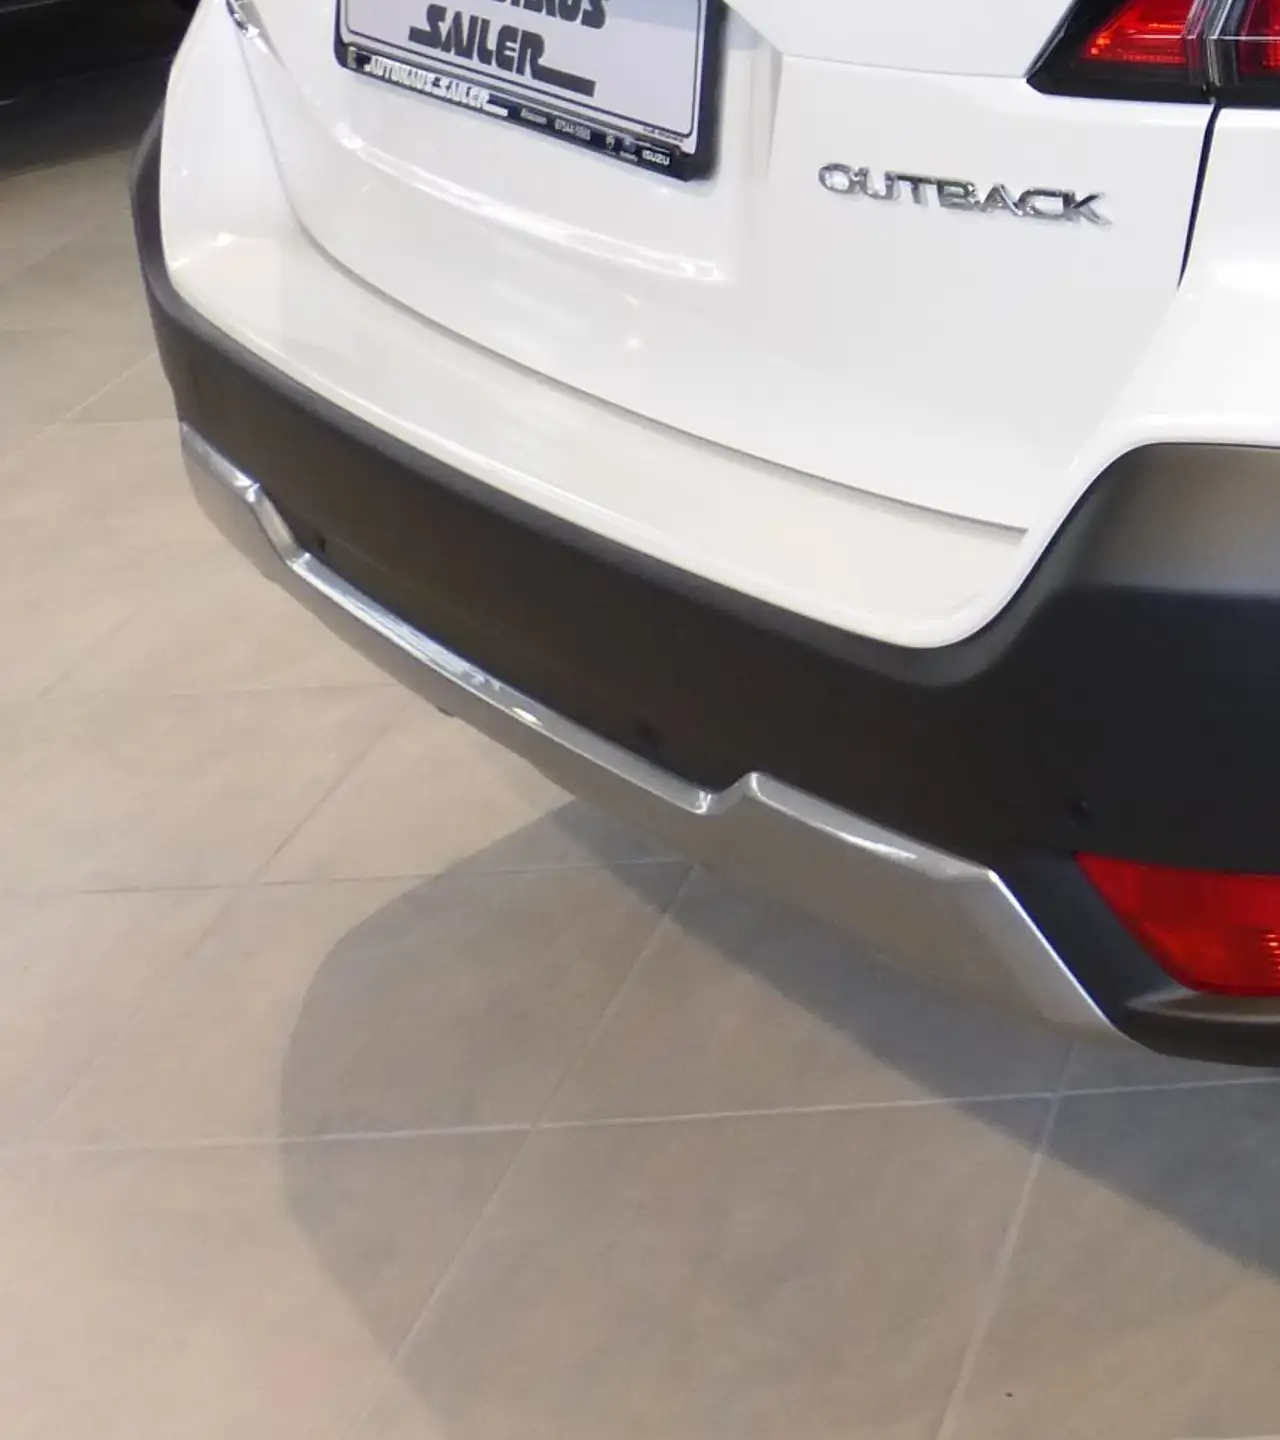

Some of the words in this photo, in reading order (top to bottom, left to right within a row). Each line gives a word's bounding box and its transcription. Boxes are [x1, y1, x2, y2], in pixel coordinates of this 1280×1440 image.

[364, 55, 434, 93] AUTOHAUS
[408, 4, 596, 97] SAILER
[818, 162, 1113, 226] OUTBACK
